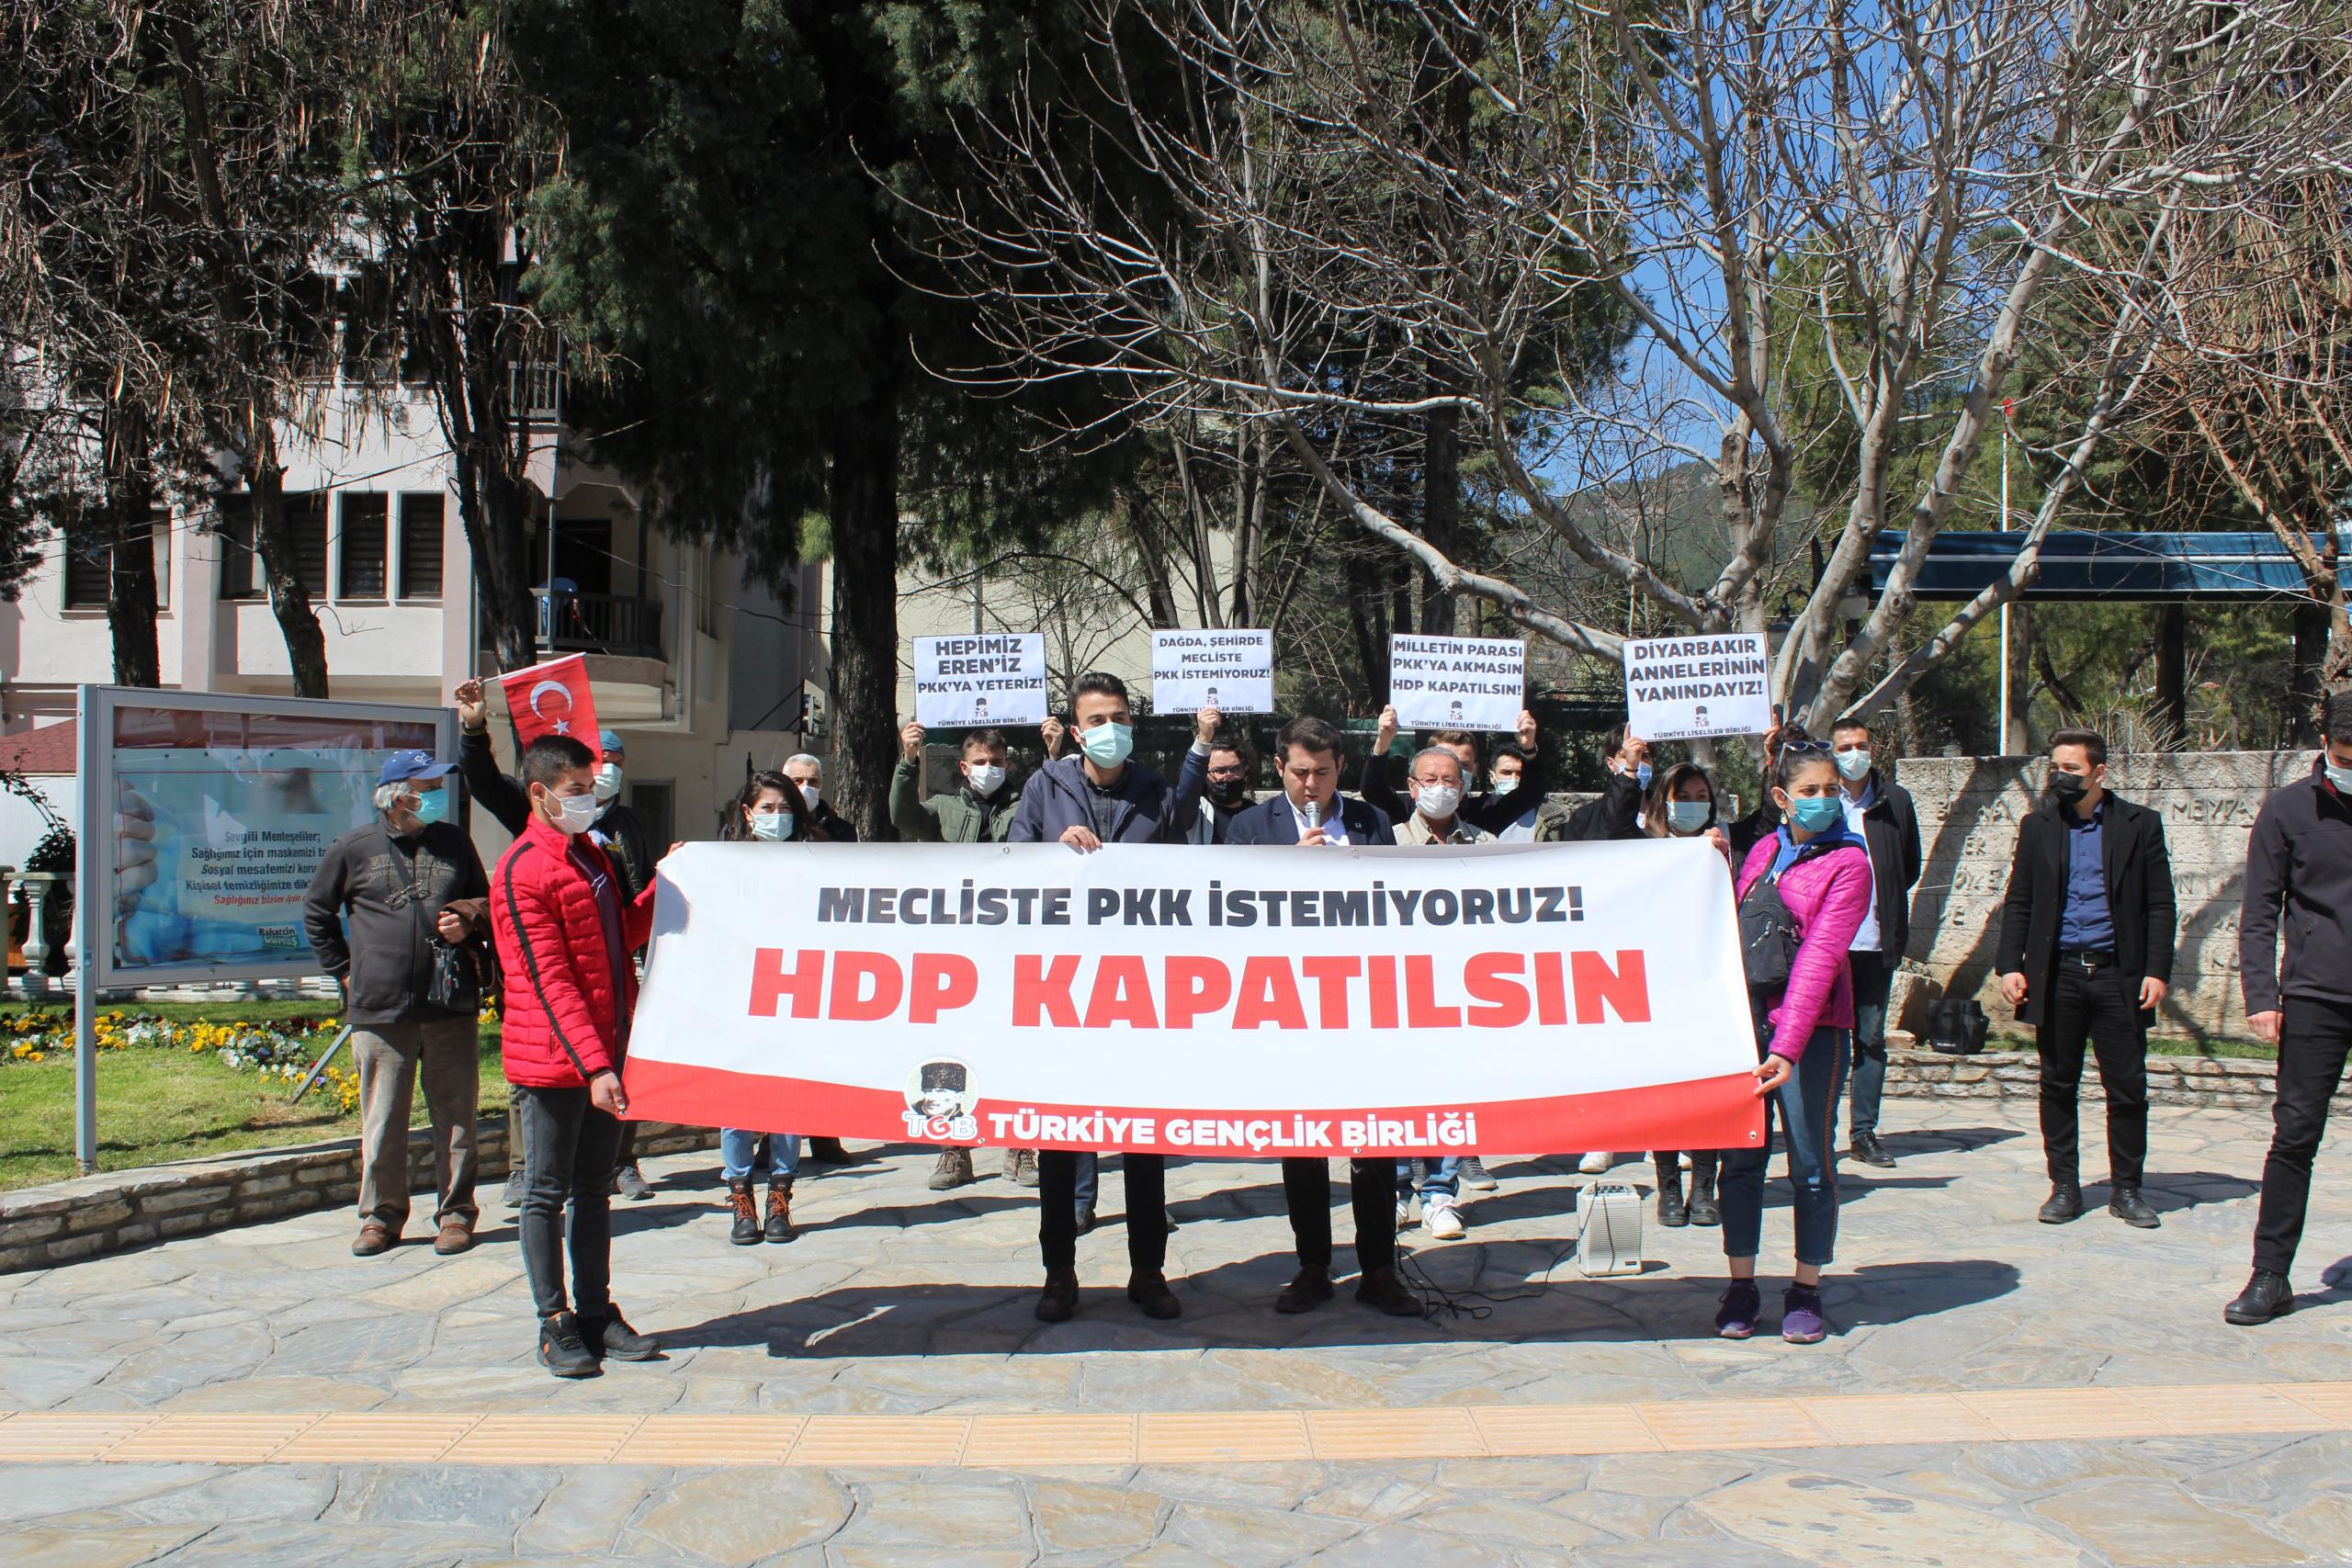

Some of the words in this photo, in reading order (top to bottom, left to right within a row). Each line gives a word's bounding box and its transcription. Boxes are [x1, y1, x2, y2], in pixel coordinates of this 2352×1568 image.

[935, 636, 1023, 656] HEPİMİZ
[1159, 636, 1207, 648] DAĞDA,
[1209, 635, 1264, 648] ŞEHİRDE
[1394, 639, 1464, 654] MİLLETİN
[1467, 645, 1522, 657] PARASI
[1182, 650, 1242, 663] MECLİSTE
[1634, 639, 1758, 660] DİYARBAKIR
[1154, 671, 1179, 680] PKK
[1182, 668, 1271, 680] İSTEMİYORUZ!
[1452, 661, 1523, 674] AKMASIN
[1629, 657, 1765, 682] ANNELERİNİN
[976, 676, 1044, 691] YETERİZ!
[1392, 679, 1424, 691] HDP
[1428, 681, 1521, 695] KAPATILSIN!
[1634, 681, 1763, 703] YANINDAYIZ!
[967, 717, 1001, 726] LİSELİLER
[1411, 719, 1440, 728] TÜRKİYE
[1654, 730, 1686, 739] TÜRKİYE
[1687, 728, 1724, 737] LİSELİLER
[1724, 726, 1751, 734] BİRLİĞİ
[224, 830, 258, 844] Sevgili
[262, 830, 322, 845] Menteşeliler;
[191, 847, 241, 861] Sağlığımız
[243, 848, 264, 861] için
[267, 847, 316, 858] maskemizi
[201, 864, 234, 877] Sosyal
[237, 863, 296, 875] mesafemizi
[186, 879, 221, 893] Kişisel
[224, 879, 292, 893] temizliğimize
[214, 895, 259, 907] Sağlığınız
[262, 895, 285, 905] bizim
[286, 894, 301, 904] için
[817, 878, 1073, 927] MECLİSTE
[1087, 887, 1194, 927] PKK
[1208, 878, 1585, 928] İSTEMİYORUZ!
[748, 947, 978, 1024] HDP
[1012, 949, 1652, 1031] KAPATILSIN
[902, 1111, 978, 1140] TGB
[988, 1108, 1156, 1144] TÜRKİYE
[1165, 1112, 1332, 1153] GENÇLİK
[1341, 1111, 1477, 1148] BİRLİĞİ
